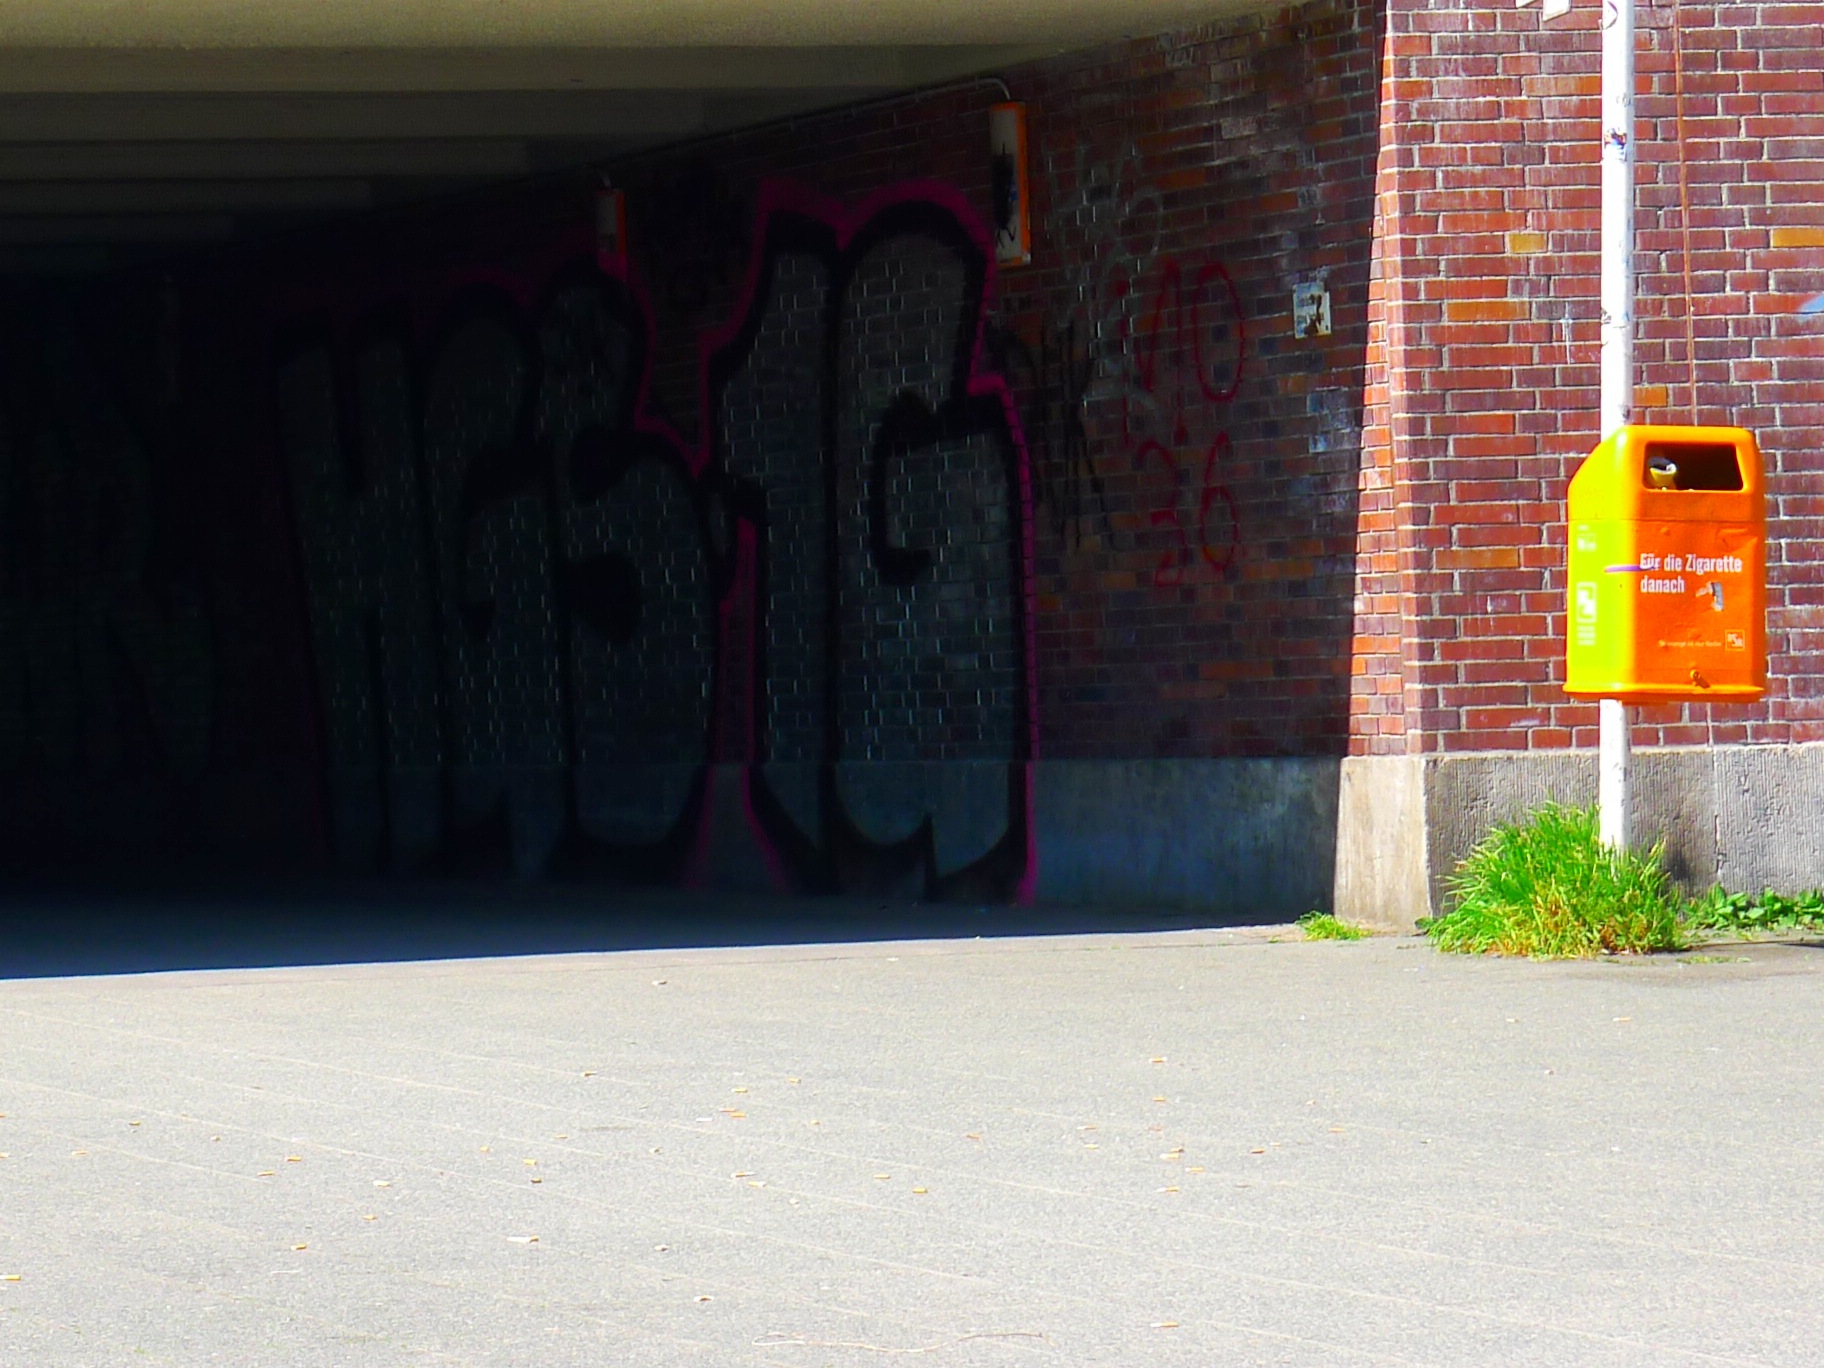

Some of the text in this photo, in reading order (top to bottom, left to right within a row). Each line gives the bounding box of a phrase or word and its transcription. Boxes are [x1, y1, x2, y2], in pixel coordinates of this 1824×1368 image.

[1664, 553, 1682, 572] die
[1685, 553, 1743, 576] Zigarette
[1640, 574, 1685, 594] danach
